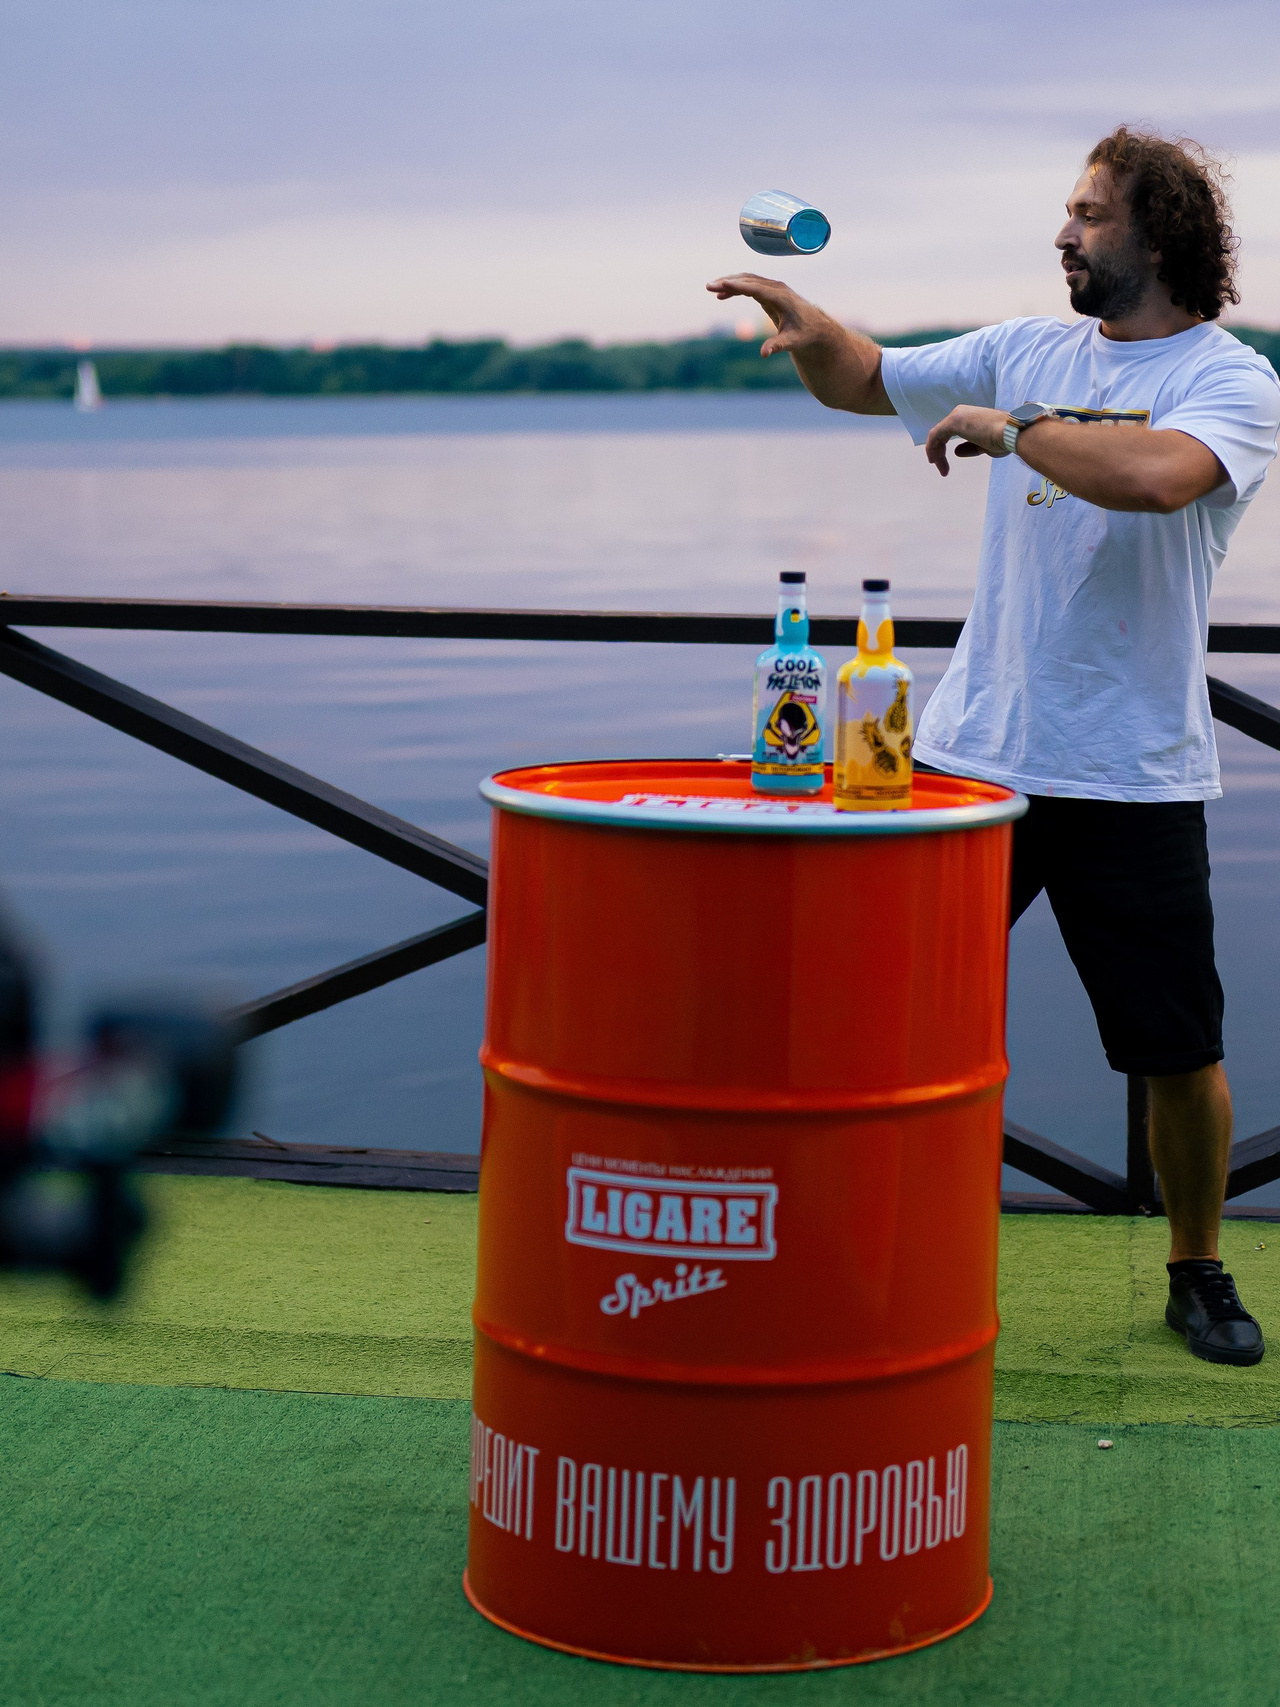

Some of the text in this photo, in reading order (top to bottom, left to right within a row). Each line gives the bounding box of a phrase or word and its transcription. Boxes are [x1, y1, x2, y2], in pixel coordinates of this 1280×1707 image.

[775, 657, 818, 674] COOL
[581, 1185, 758, 1245] LIGARE
[599, 1262, 727, 1319] Spritz
[554, 1455, 737, 1575] ВАШЕМУ
[765, 1443, 968, 1575] ЗДОРОВЬЮ
